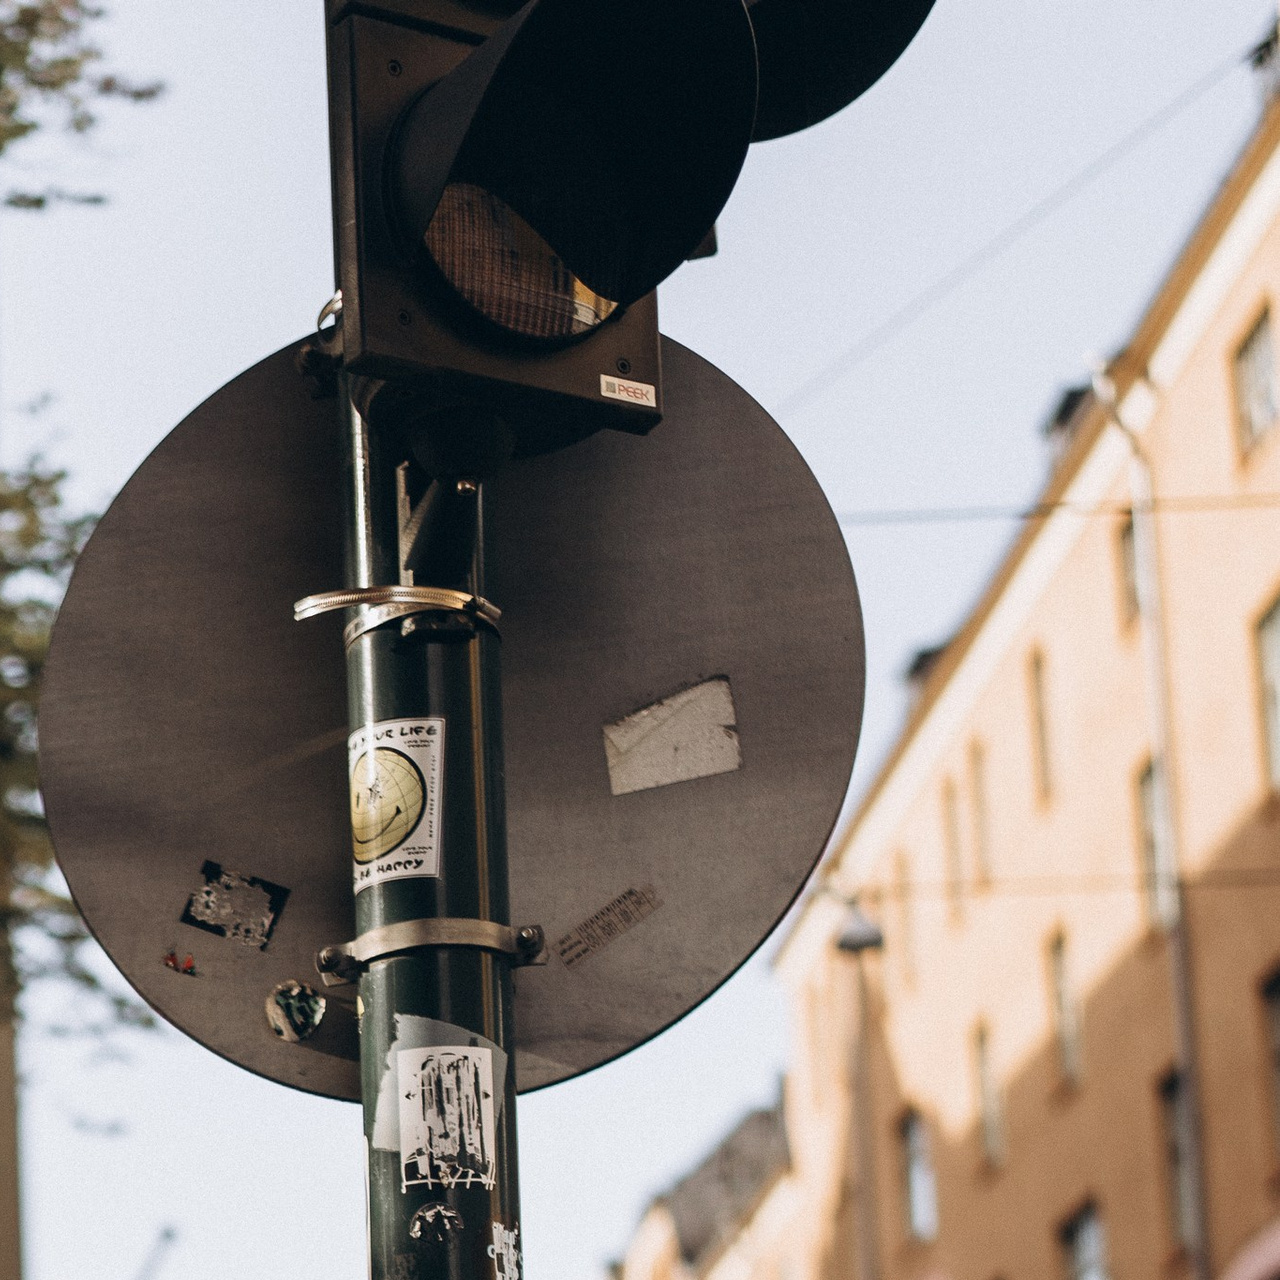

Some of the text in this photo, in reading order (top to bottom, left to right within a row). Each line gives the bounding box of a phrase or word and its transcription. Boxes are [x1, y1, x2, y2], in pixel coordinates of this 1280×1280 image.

[617, 383, 651, 401] PEEK
[400, 725, 437, 737] LIFE
[377, 858, 424, 873] HAPPY
